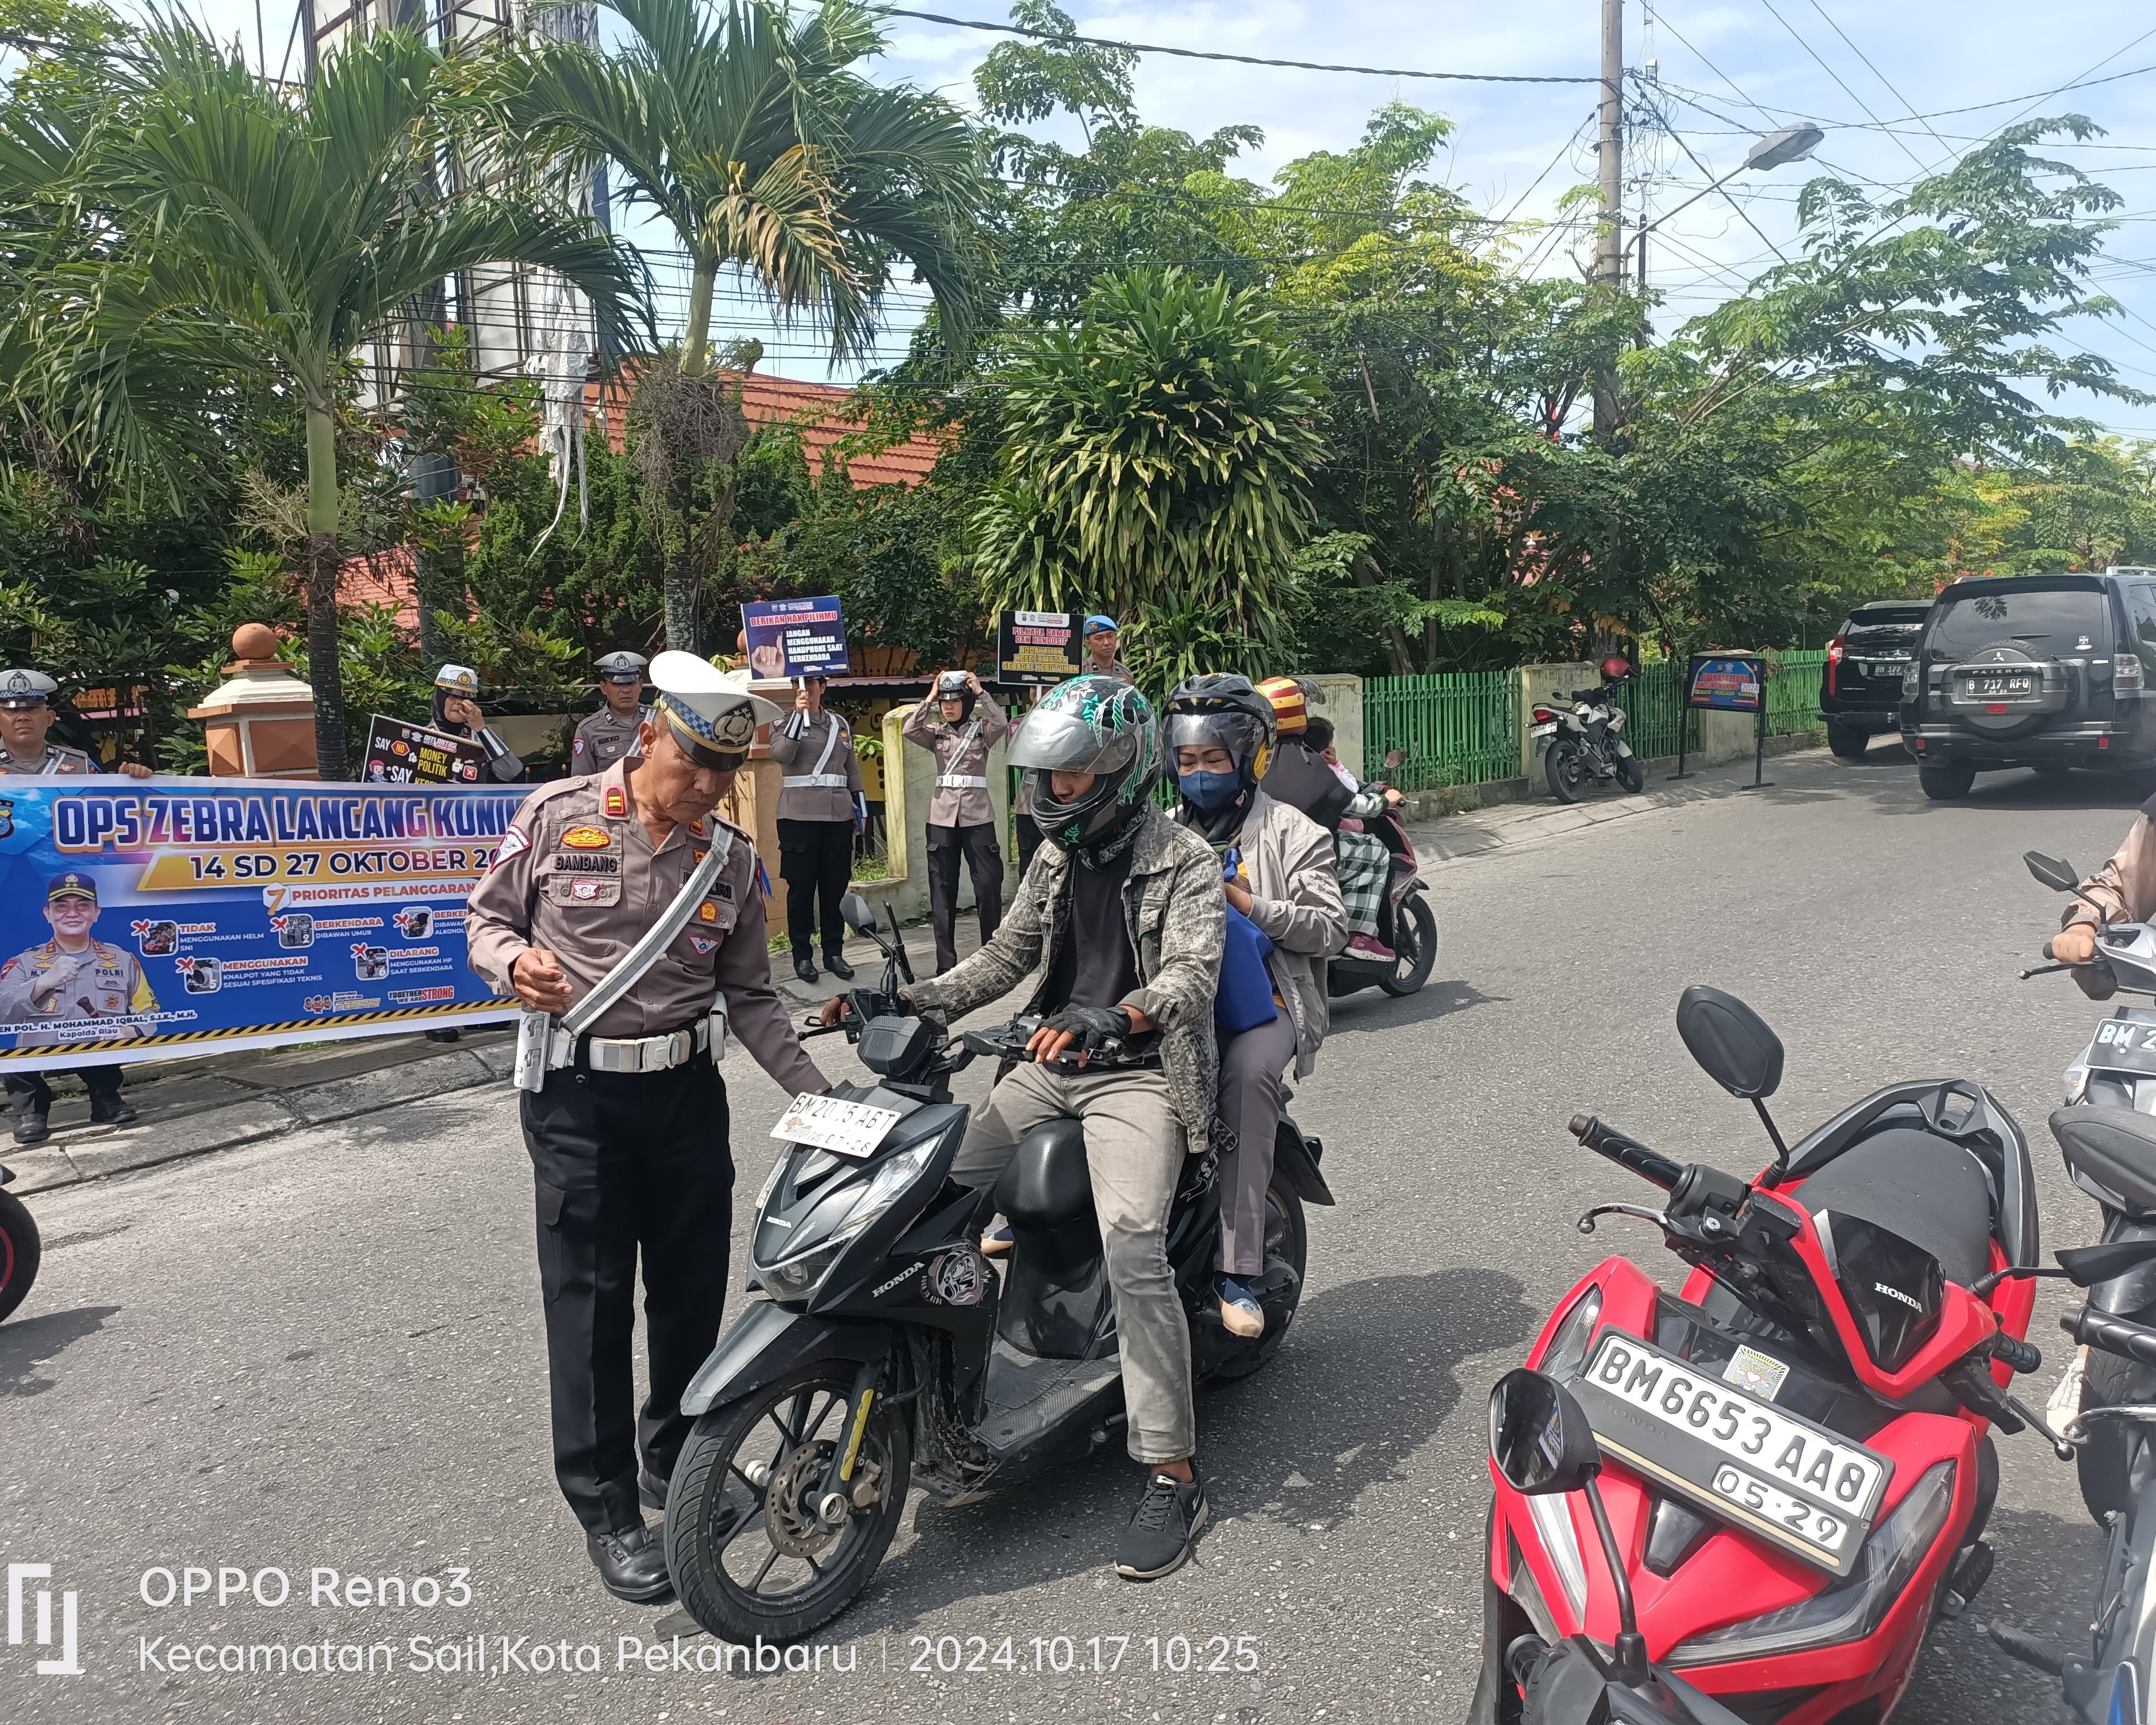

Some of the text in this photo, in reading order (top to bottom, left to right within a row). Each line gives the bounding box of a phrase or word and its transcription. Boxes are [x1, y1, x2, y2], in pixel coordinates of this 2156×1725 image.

[751, 611, 837, 626] BERIKAN HAK PILIHMU
[1012, 627, 1071, 637] PILKADA DAMAI
[827, 643, 843, 651] SAAT
[1019, 646, 1064, 656] BUDAYAKAN
[1014, 654, 1068, 664] KESELAMATAN
[1002, 661, 1079, 673] SEBAGAI KEBUTUHAN
[1742, 684, 1758, 692] 2024
[1969, 678, 2028, 690] B 717 RFQ
[375, 737, 391, 751] SAY
[395, 742, 405, 753] NO
[420, 747, 448, 764] MONEY
[417, 759, 448, 777] POLITIK
[391, 765, 413, 784] SAY
[56, 797, 140, 848] OPS
[148, 797, 273, 846] ZEBRA
[275, 796, 428, 843] LANCANG
[190, 855, 225, 880] 14
[235, 854, 277, 878] SD
[286, 853, 320, 876] 27
[328, 850, 466, 875] OKTOBER
[554, 854, 617, 872] BAMBANG
[292, 882, 477, 902] PRIORITAS PELANGGARAN
[267, 888, 287, 915] 7
[179, 923, 215, 933] TIDAK
[315, 918, 383, 929] BERKENDARA
[180, 934, 241, 943] MENGGUNAKAN
[302, 934, 310, 944] 2
[390, 948, 438, 958] DILARANG
[223, 957, 307, 971] MENGGUNAKAN
[409, 965, 453, 973] BERKENDARA
[95, 968, 124, 976] POLRI
[223, 972, 258, 980] KNALPOT
[378, 967, 386, 976] 6
[252, 977, 296, 986] SPESIFIKASI
[422, 987, 454, 1000] STRONG
[14, 1024, 37, 1032] POL.
[53, 1018, 113, 1029] MOHAMMAD
[116, 1015, 147, 1025] IQBAL,
[60, 1029, 95, 1040] Kapolda
[2097, 1023, 2136, 1047] BM
[871, 1261, 925, 1298] HONDA
[1874, 1282, 1923, 1313] HONDA
[1659, 1377, 1771, 1455] 6653
